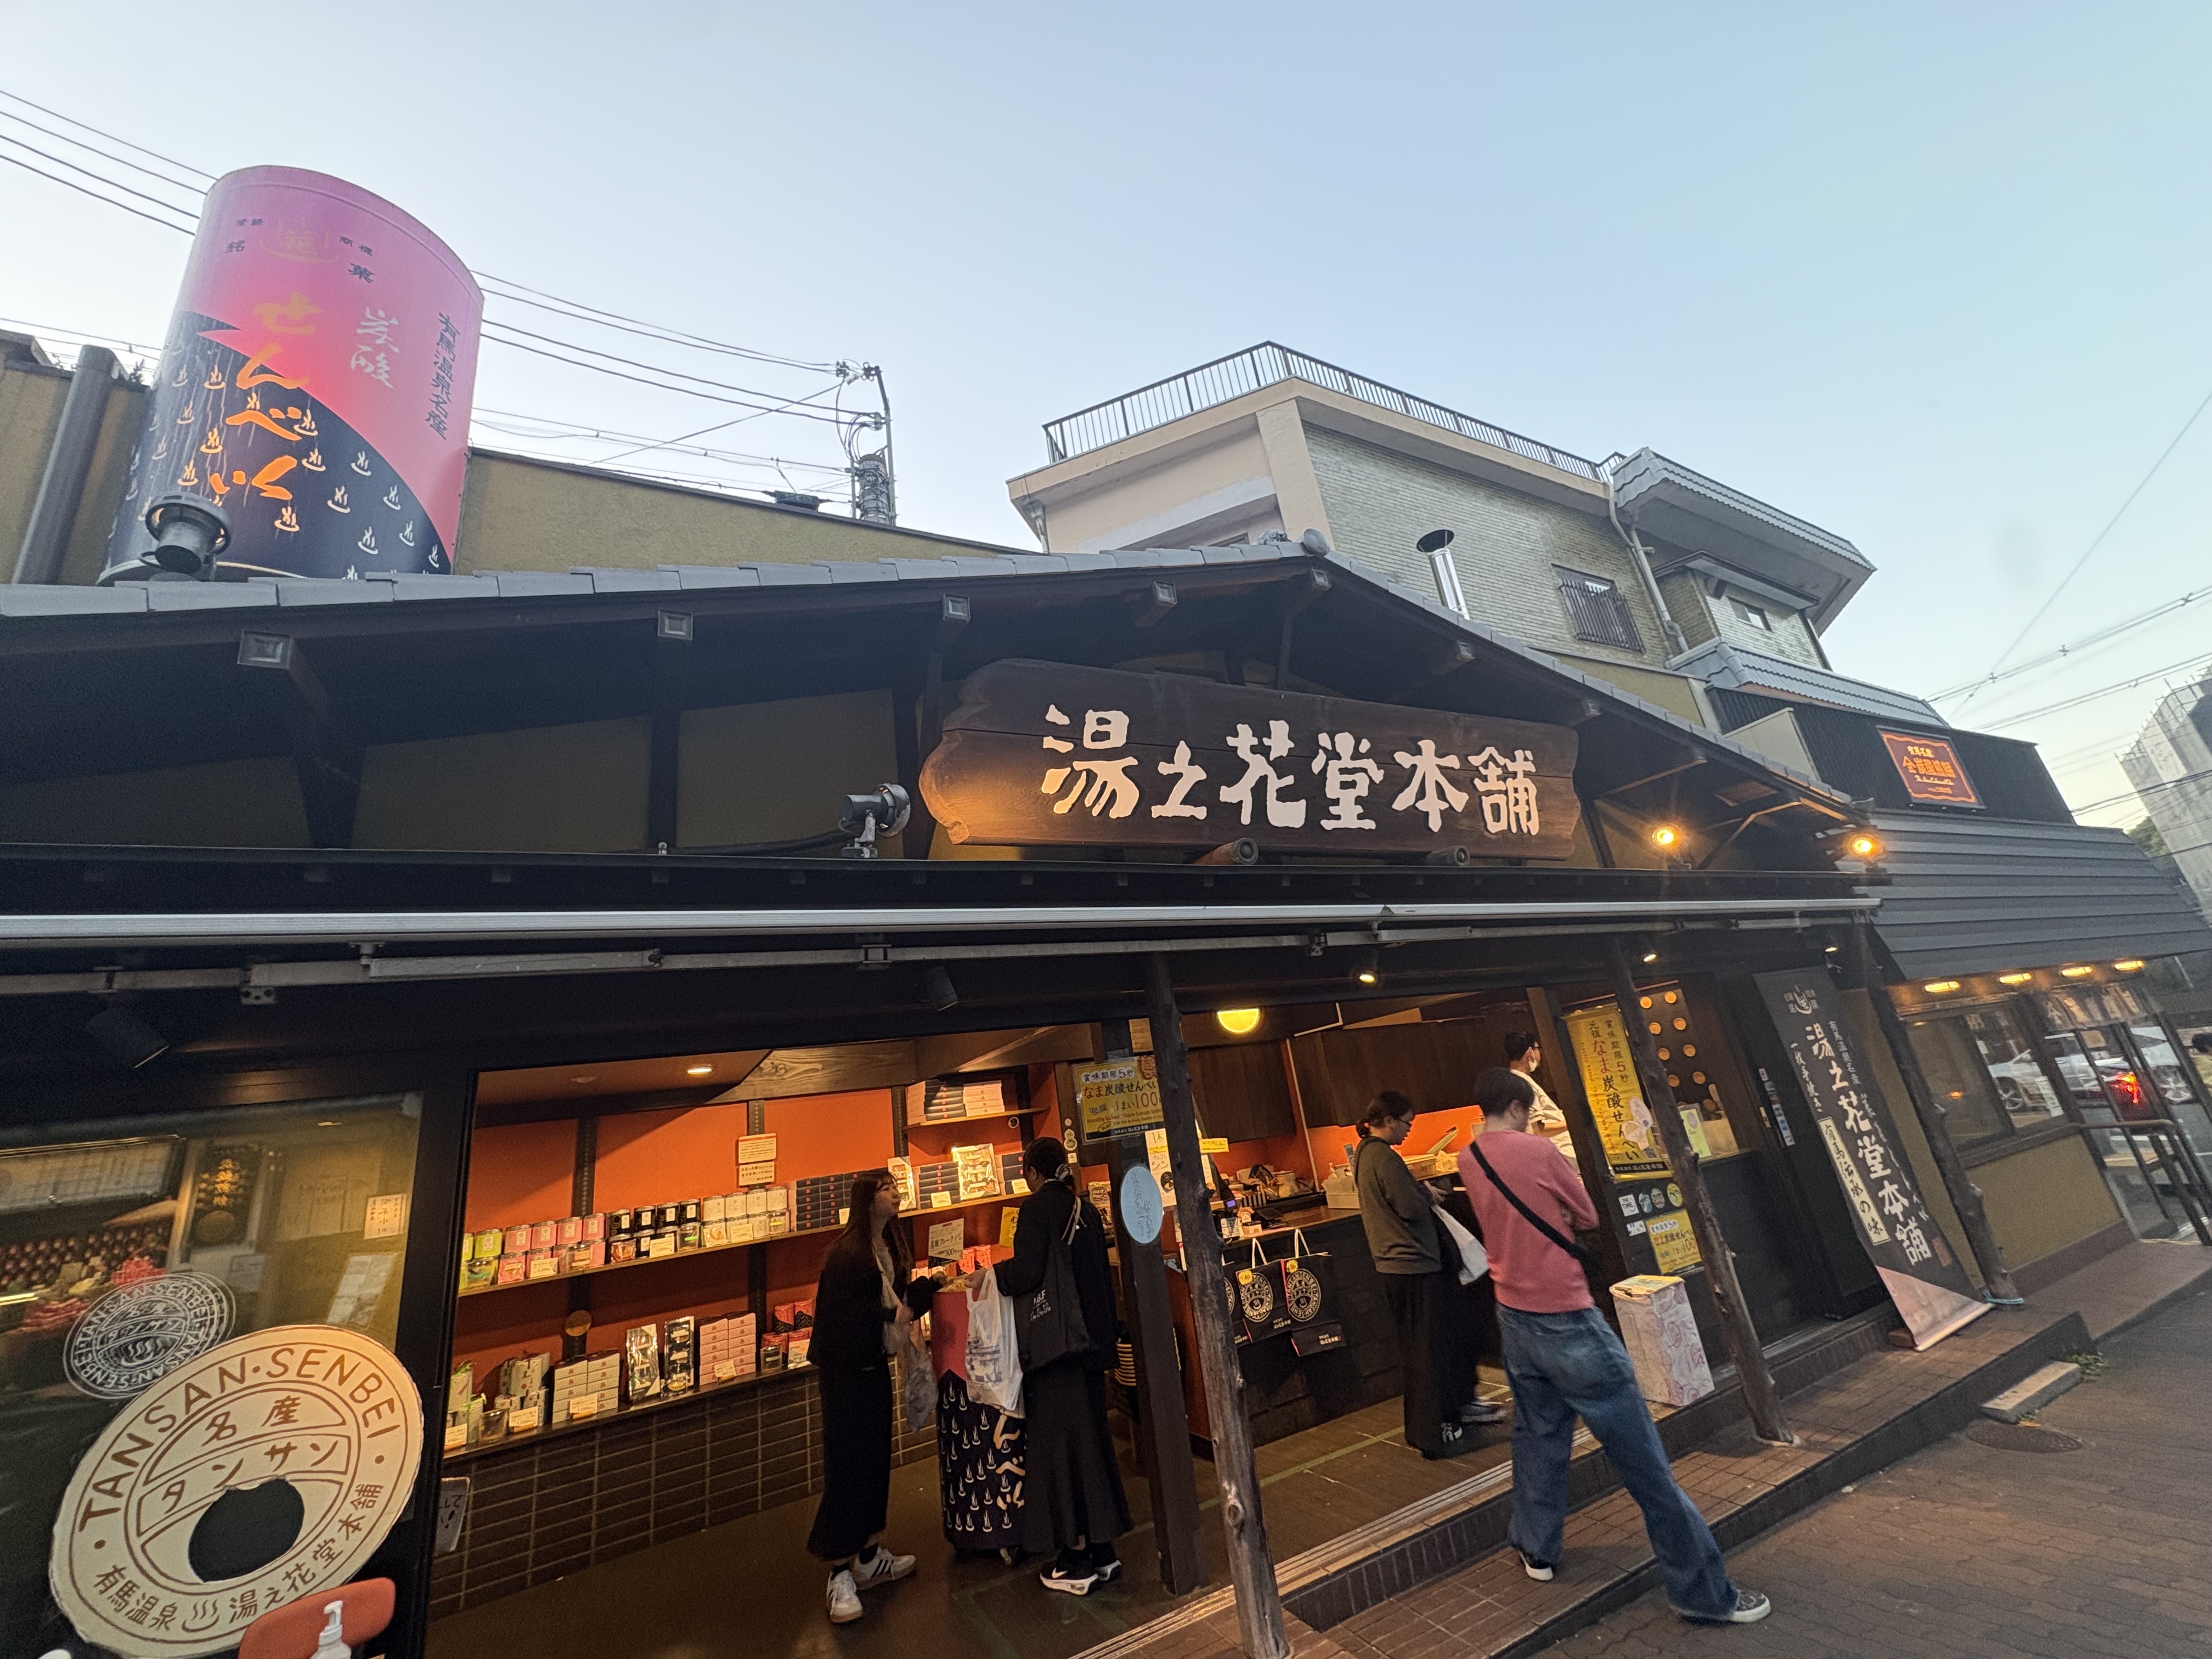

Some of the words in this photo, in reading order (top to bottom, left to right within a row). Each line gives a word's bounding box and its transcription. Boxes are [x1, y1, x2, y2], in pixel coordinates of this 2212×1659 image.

[201, 1395, 301, 1446] 名産
[162, 1440, 338, 1513] タンサン
